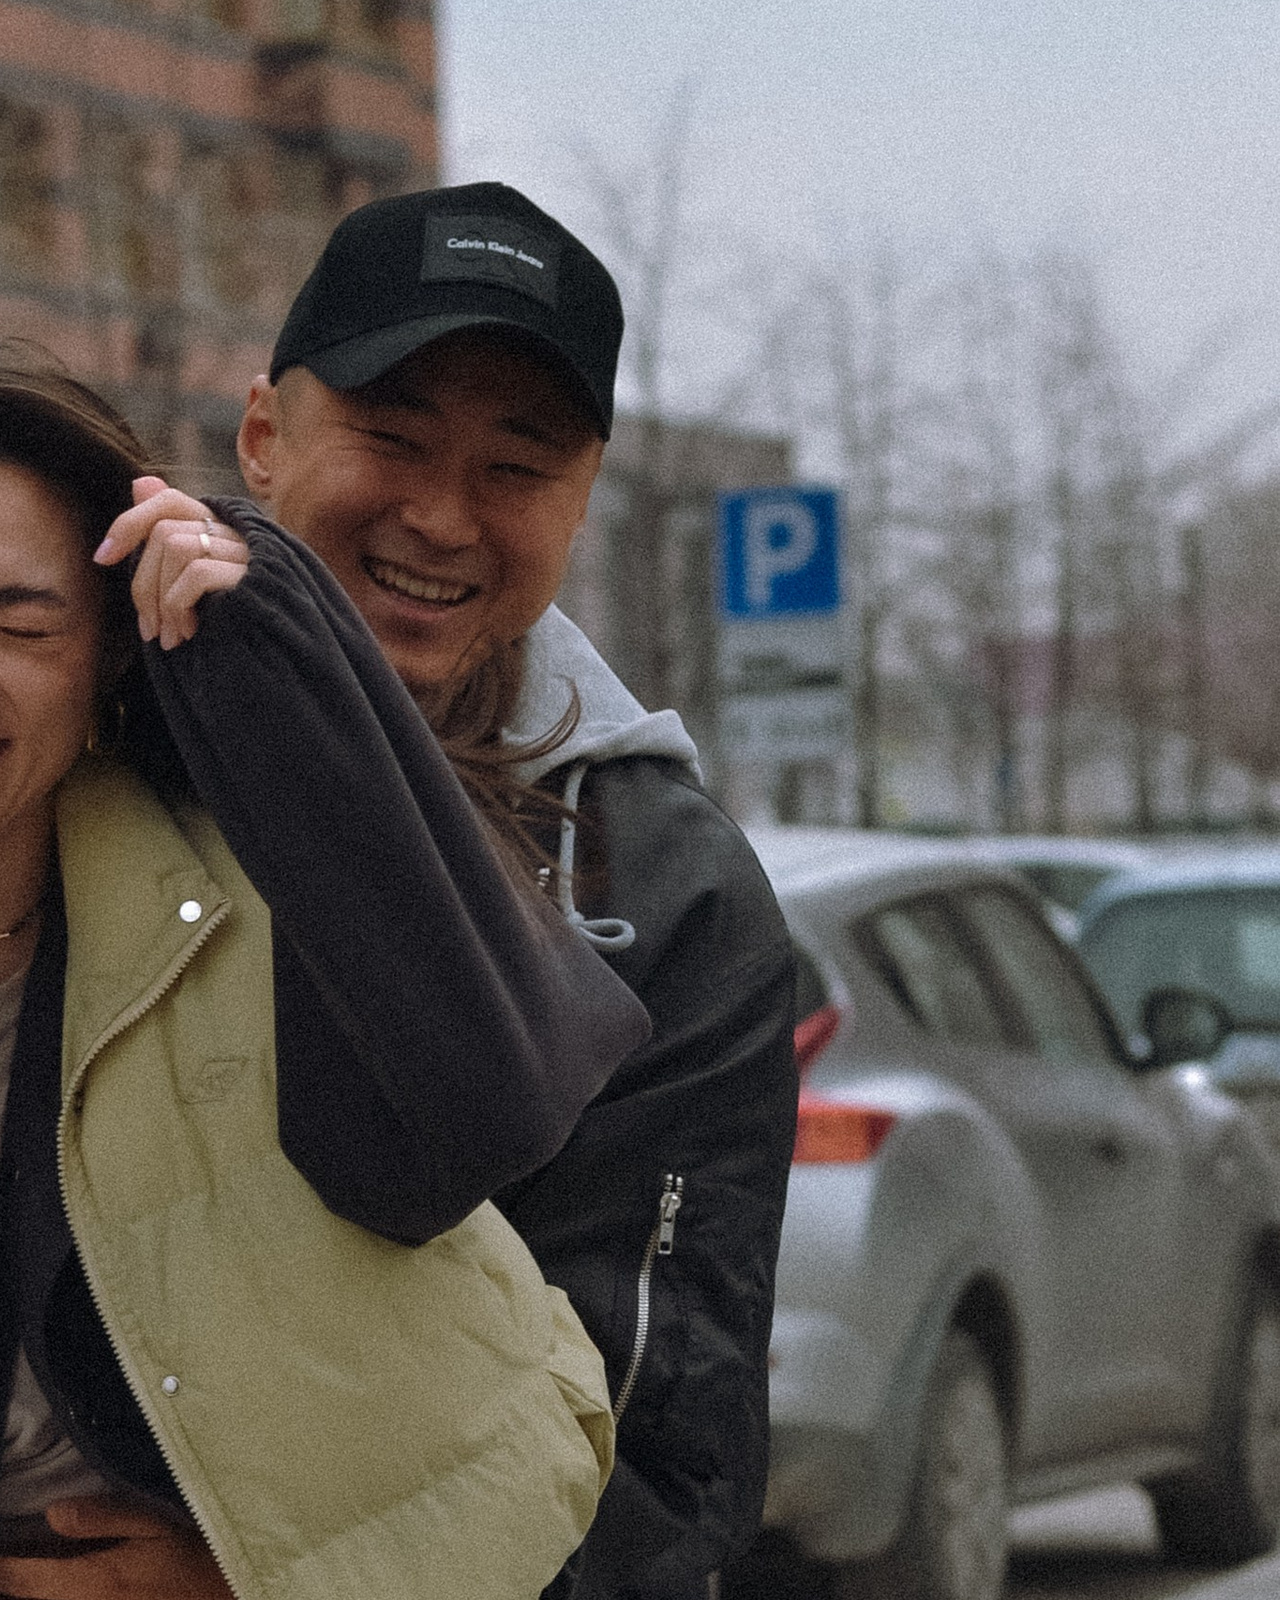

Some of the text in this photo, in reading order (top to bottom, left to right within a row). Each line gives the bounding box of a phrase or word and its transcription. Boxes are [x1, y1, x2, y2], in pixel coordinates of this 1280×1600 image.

[447, 238, 485, 249] Calvin
[487, 241, 515, 256] Klein
[745, 502, 818, 605] P
